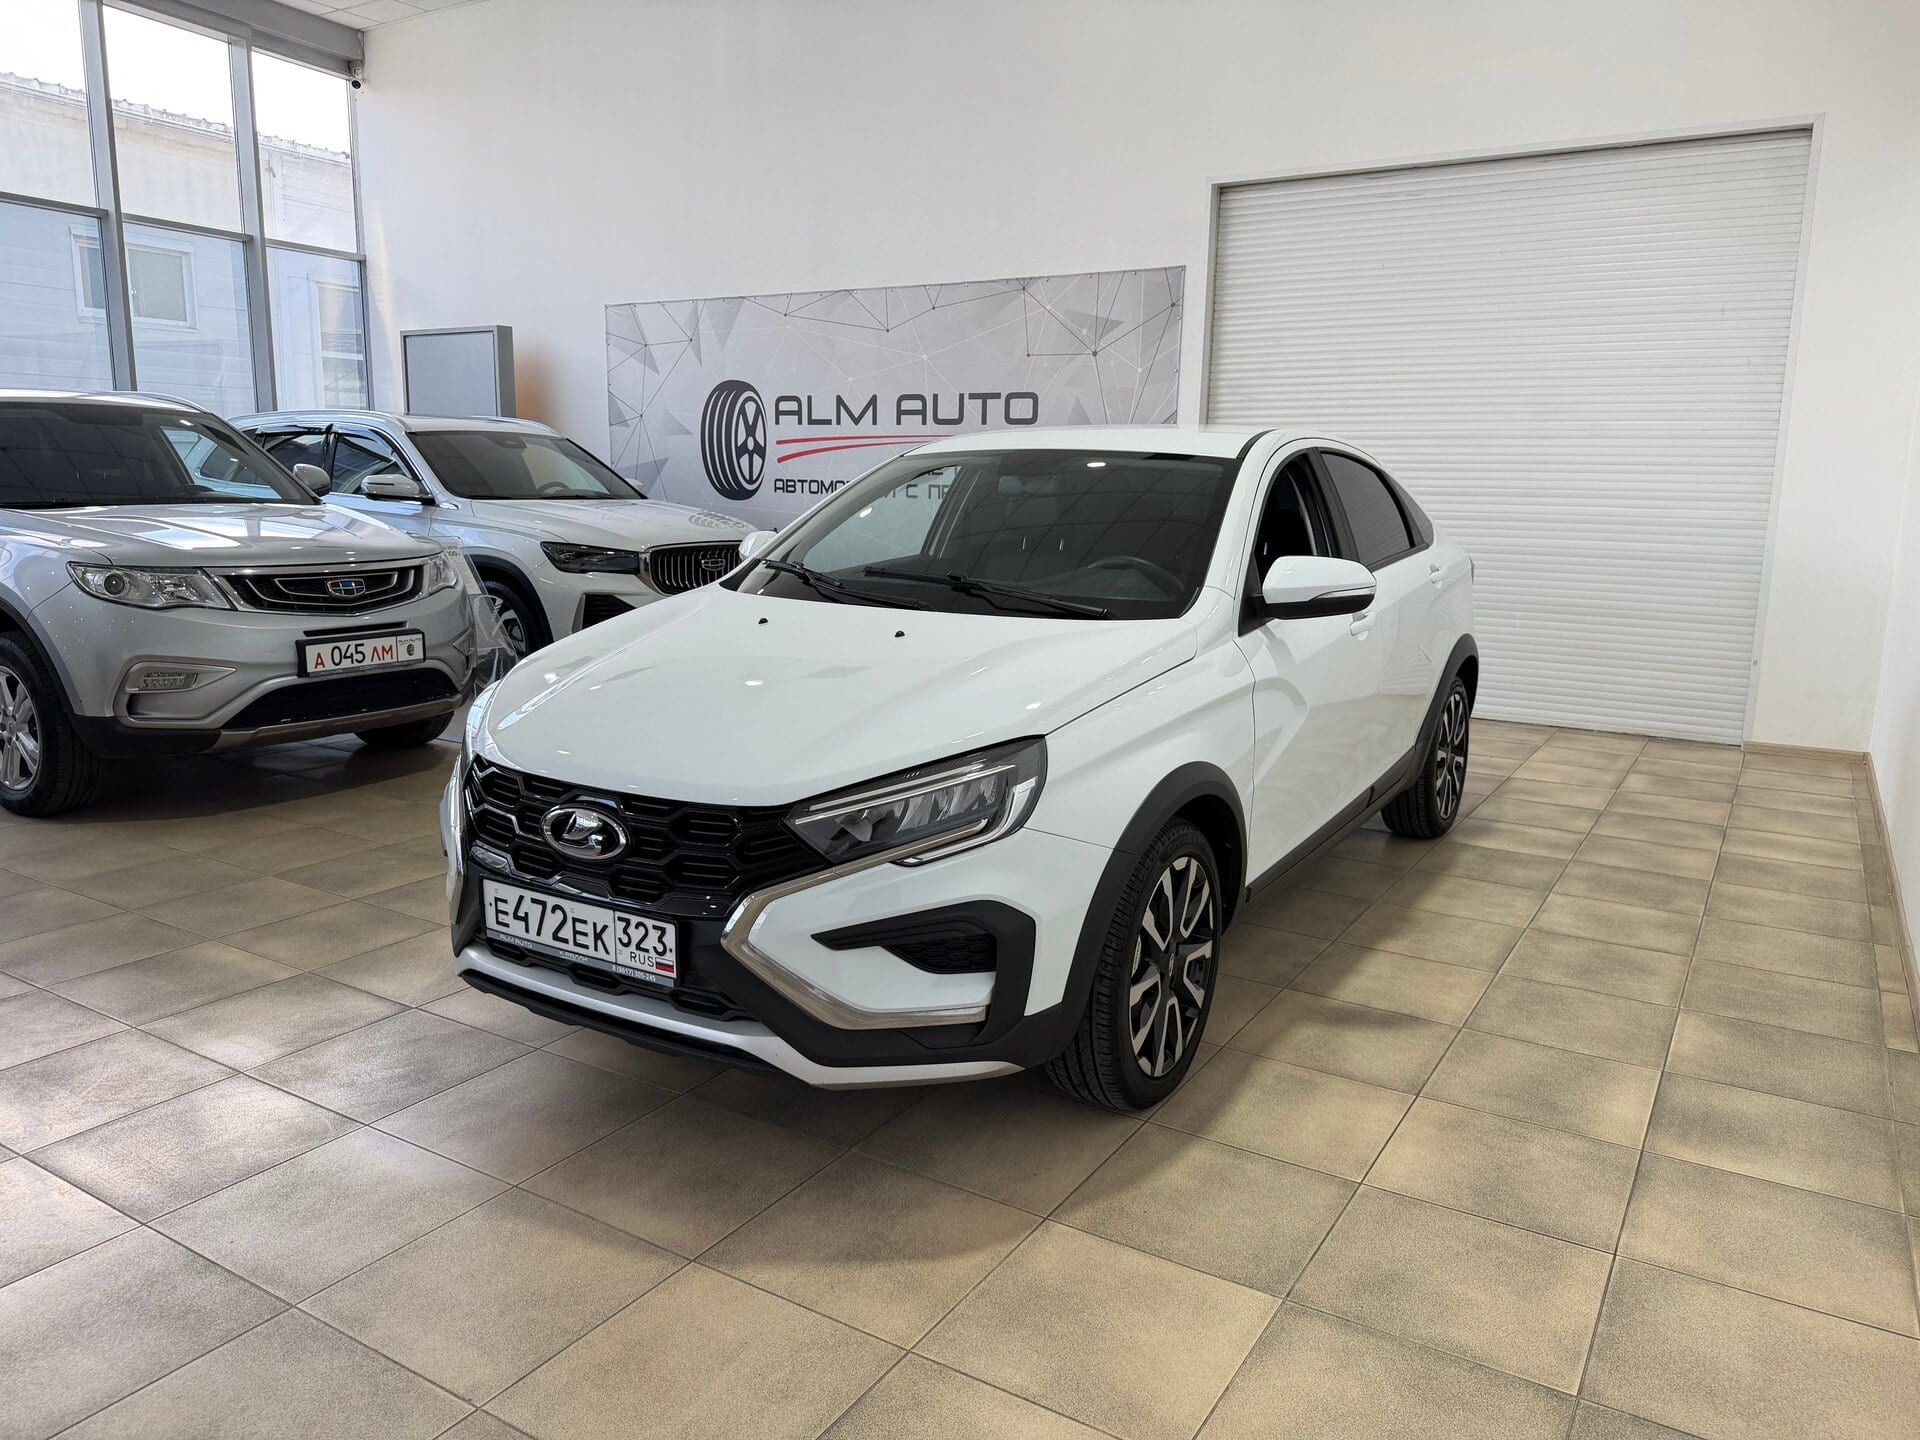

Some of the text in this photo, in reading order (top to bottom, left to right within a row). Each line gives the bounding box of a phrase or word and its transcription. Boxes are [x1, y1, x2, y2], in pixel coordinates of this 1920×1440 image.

[774, 391, 1039, 426] ALM AUTO
[314, 652, 326, 669] А
[331, 643, 366, 667] 045
[371, 644, 394, 663] ЛМ
[493, 894, 668, 957] Е472ЕК 323
[629, 951, 655, 968] RUS
